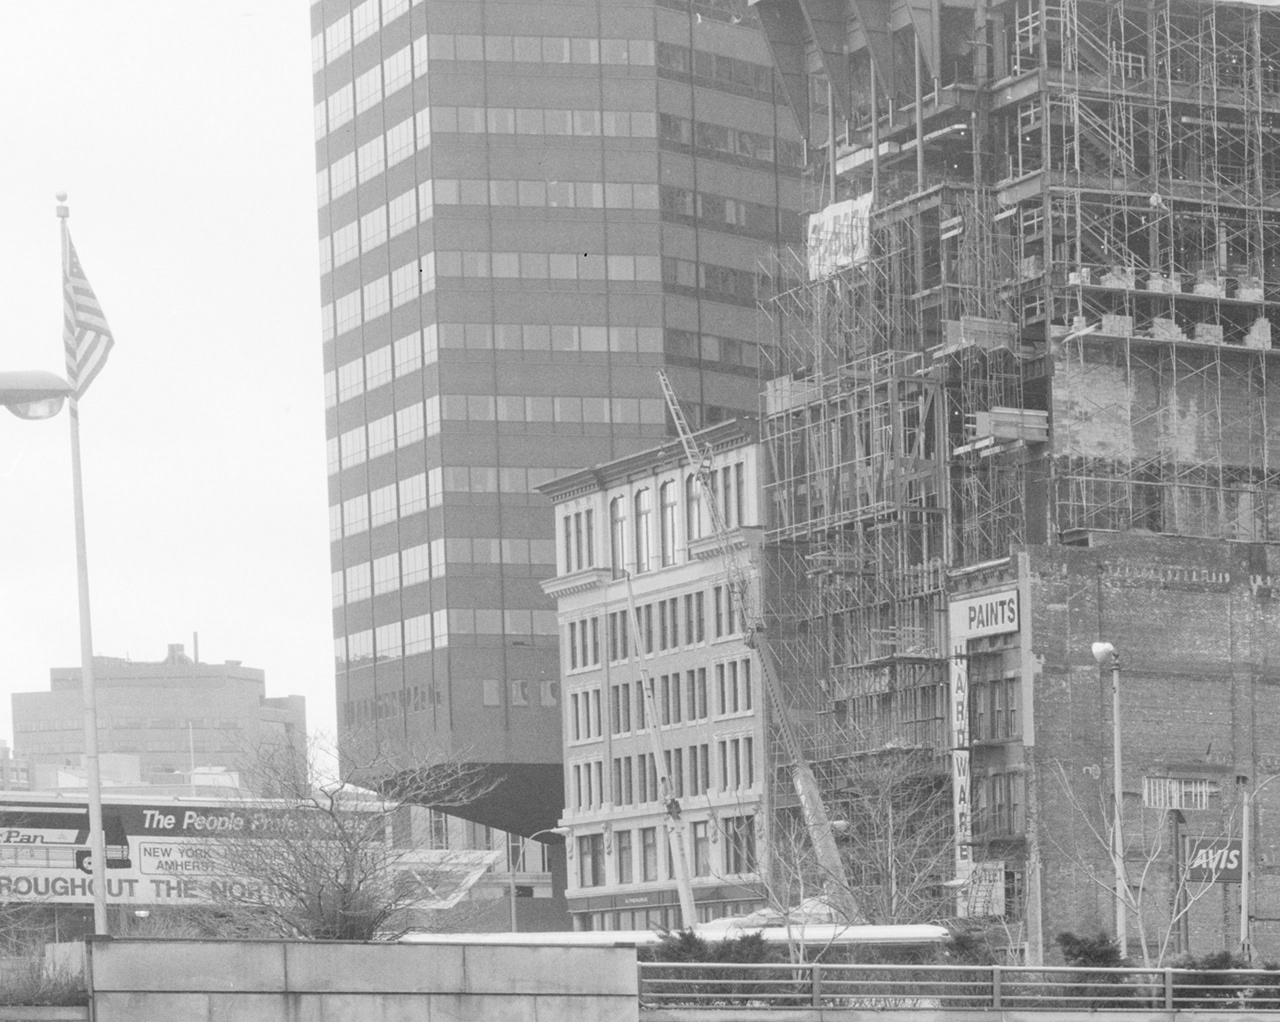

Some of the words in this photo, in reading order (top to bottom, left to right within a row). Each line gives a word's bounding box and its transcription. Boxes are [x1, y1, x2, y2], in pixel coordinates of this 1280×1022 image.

[968, 597, 1016, 630] PAINTS
[143, 810, 176, 829] The
[183, 811, 245, 831] People
[143, 847, 172, 858] NEW
[178, 848, 212, 859] YORK
[1191, 849, 1240, 869] AVIS
[150, 879, 199, 898] THE
